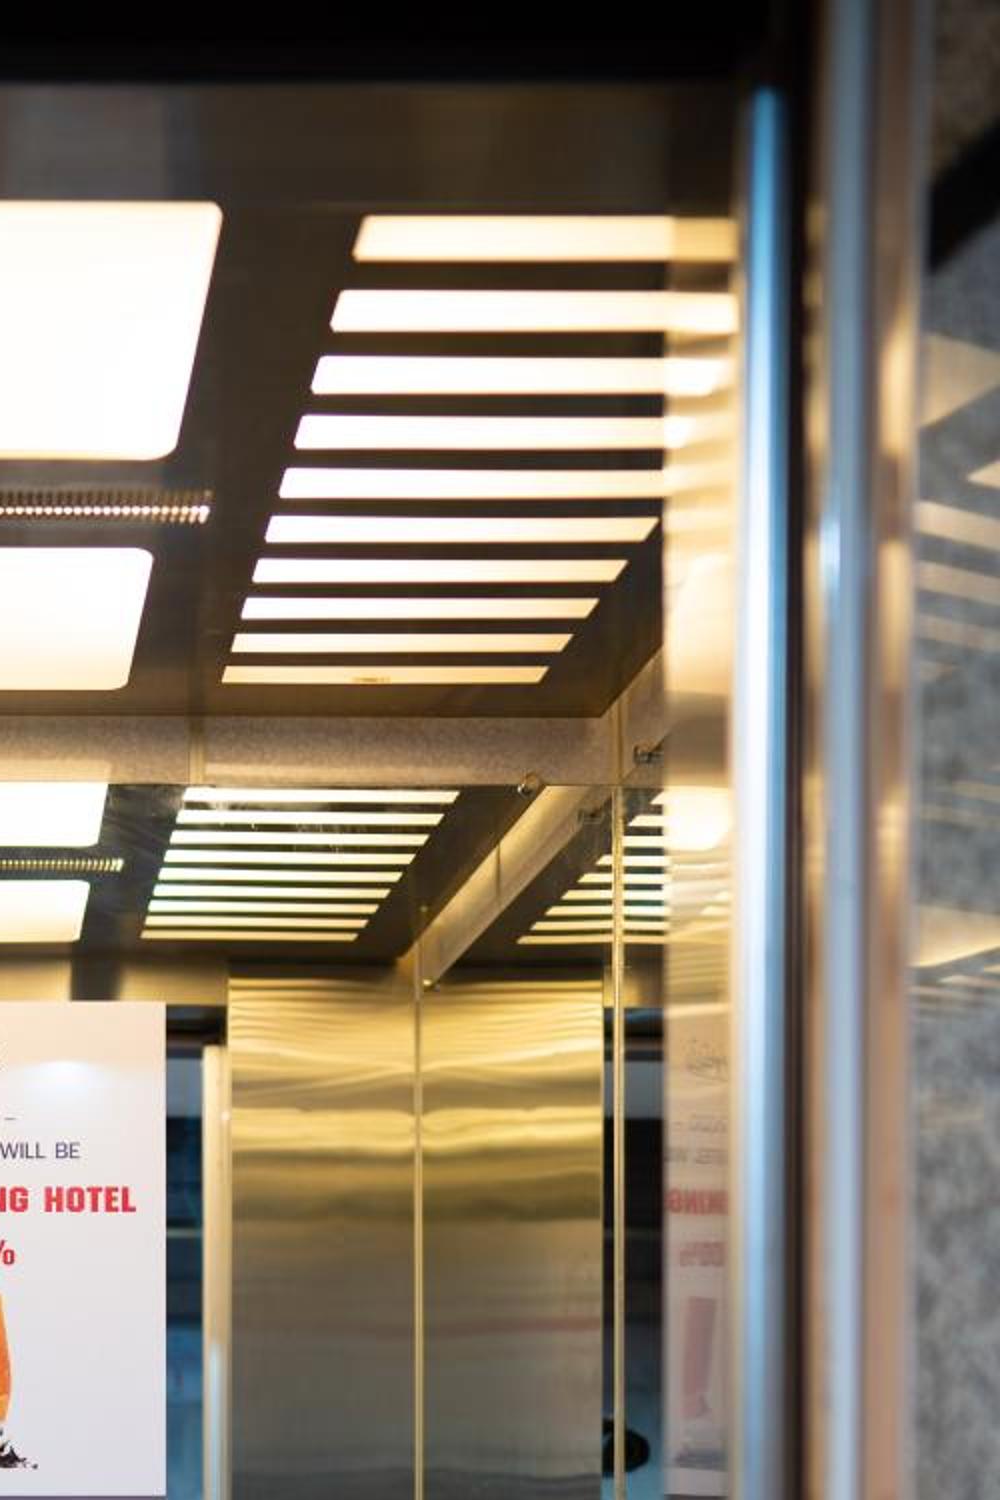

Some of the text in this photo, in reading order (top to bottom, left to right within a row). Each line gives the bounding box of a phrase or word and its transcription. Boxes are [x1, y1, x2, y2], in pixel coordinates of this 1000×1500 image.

[0, 1142, 46, 1160] WILL
[55, 1141, 81, 1160] BE
[44, 1186, 136, 1213] HOTEL
